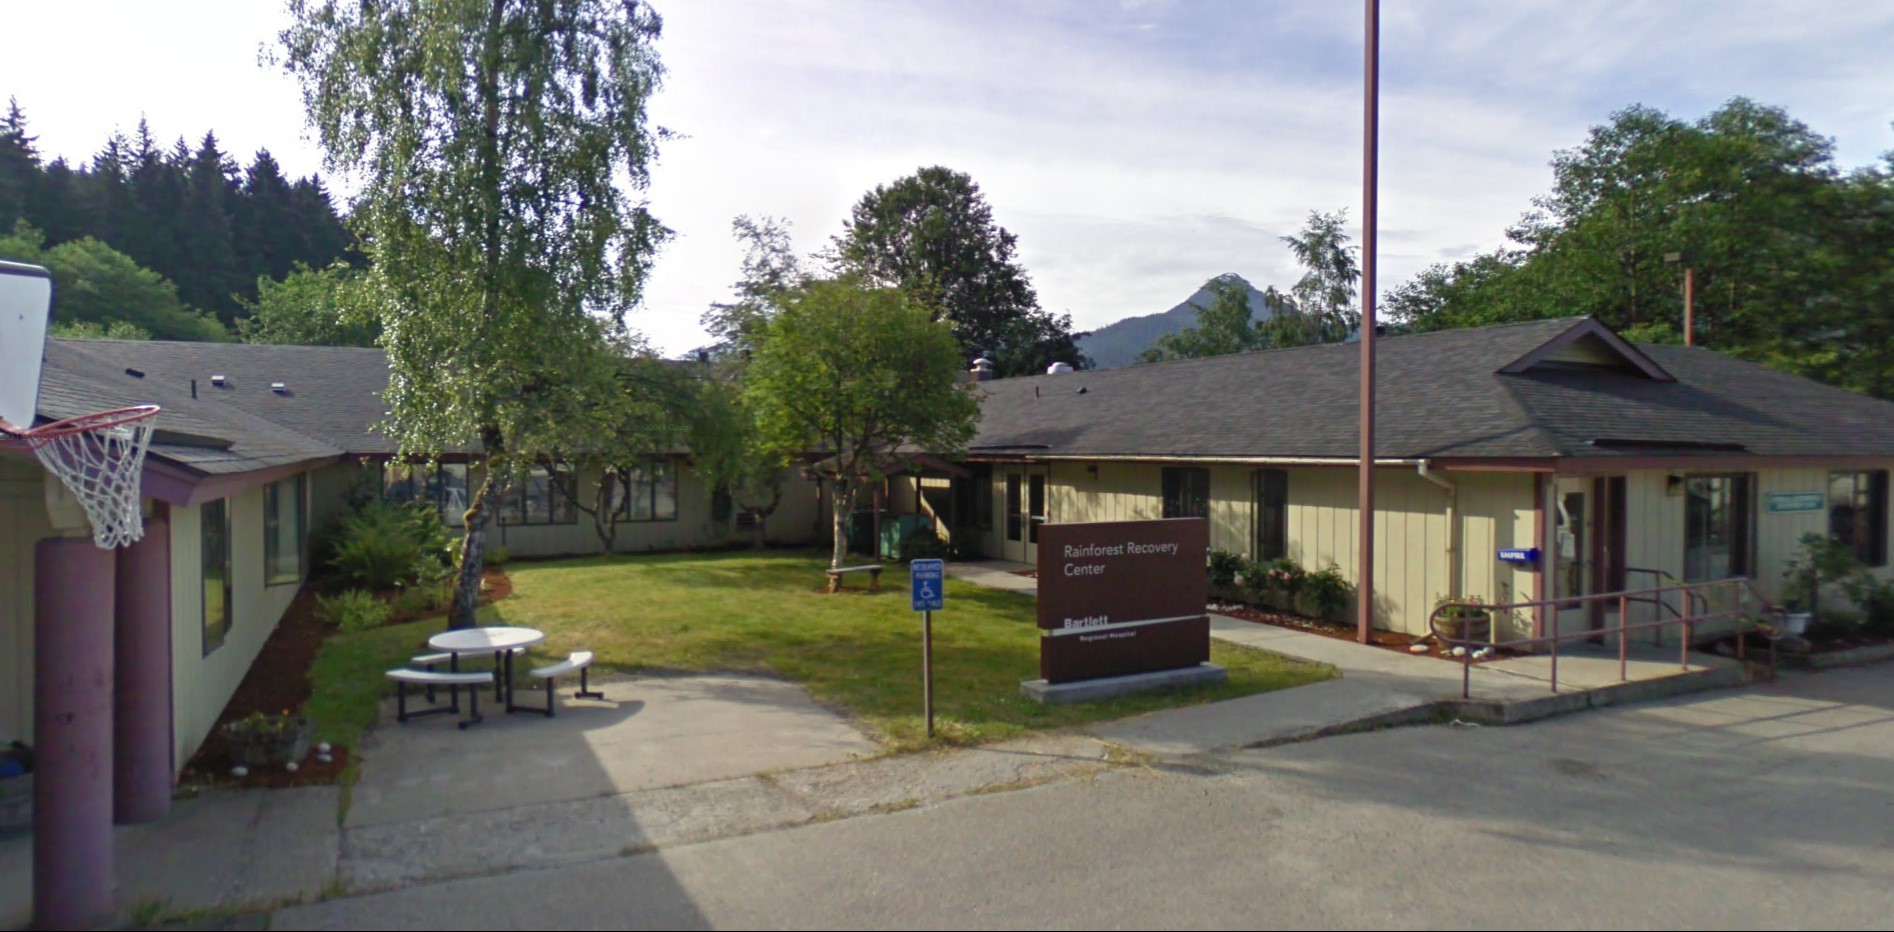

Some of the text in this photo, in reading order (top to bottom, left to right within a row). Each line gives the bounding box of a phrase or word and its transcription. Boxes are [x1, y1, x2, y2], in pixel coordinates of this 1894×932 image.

[1064, 541, 1179, 558] Rainforest Recovery
[1064, 563, 1106, 576] Center
[1064, 615, 1109, 629] Bartlett
[1079, 630, 1137, 642] Regional Hospital
